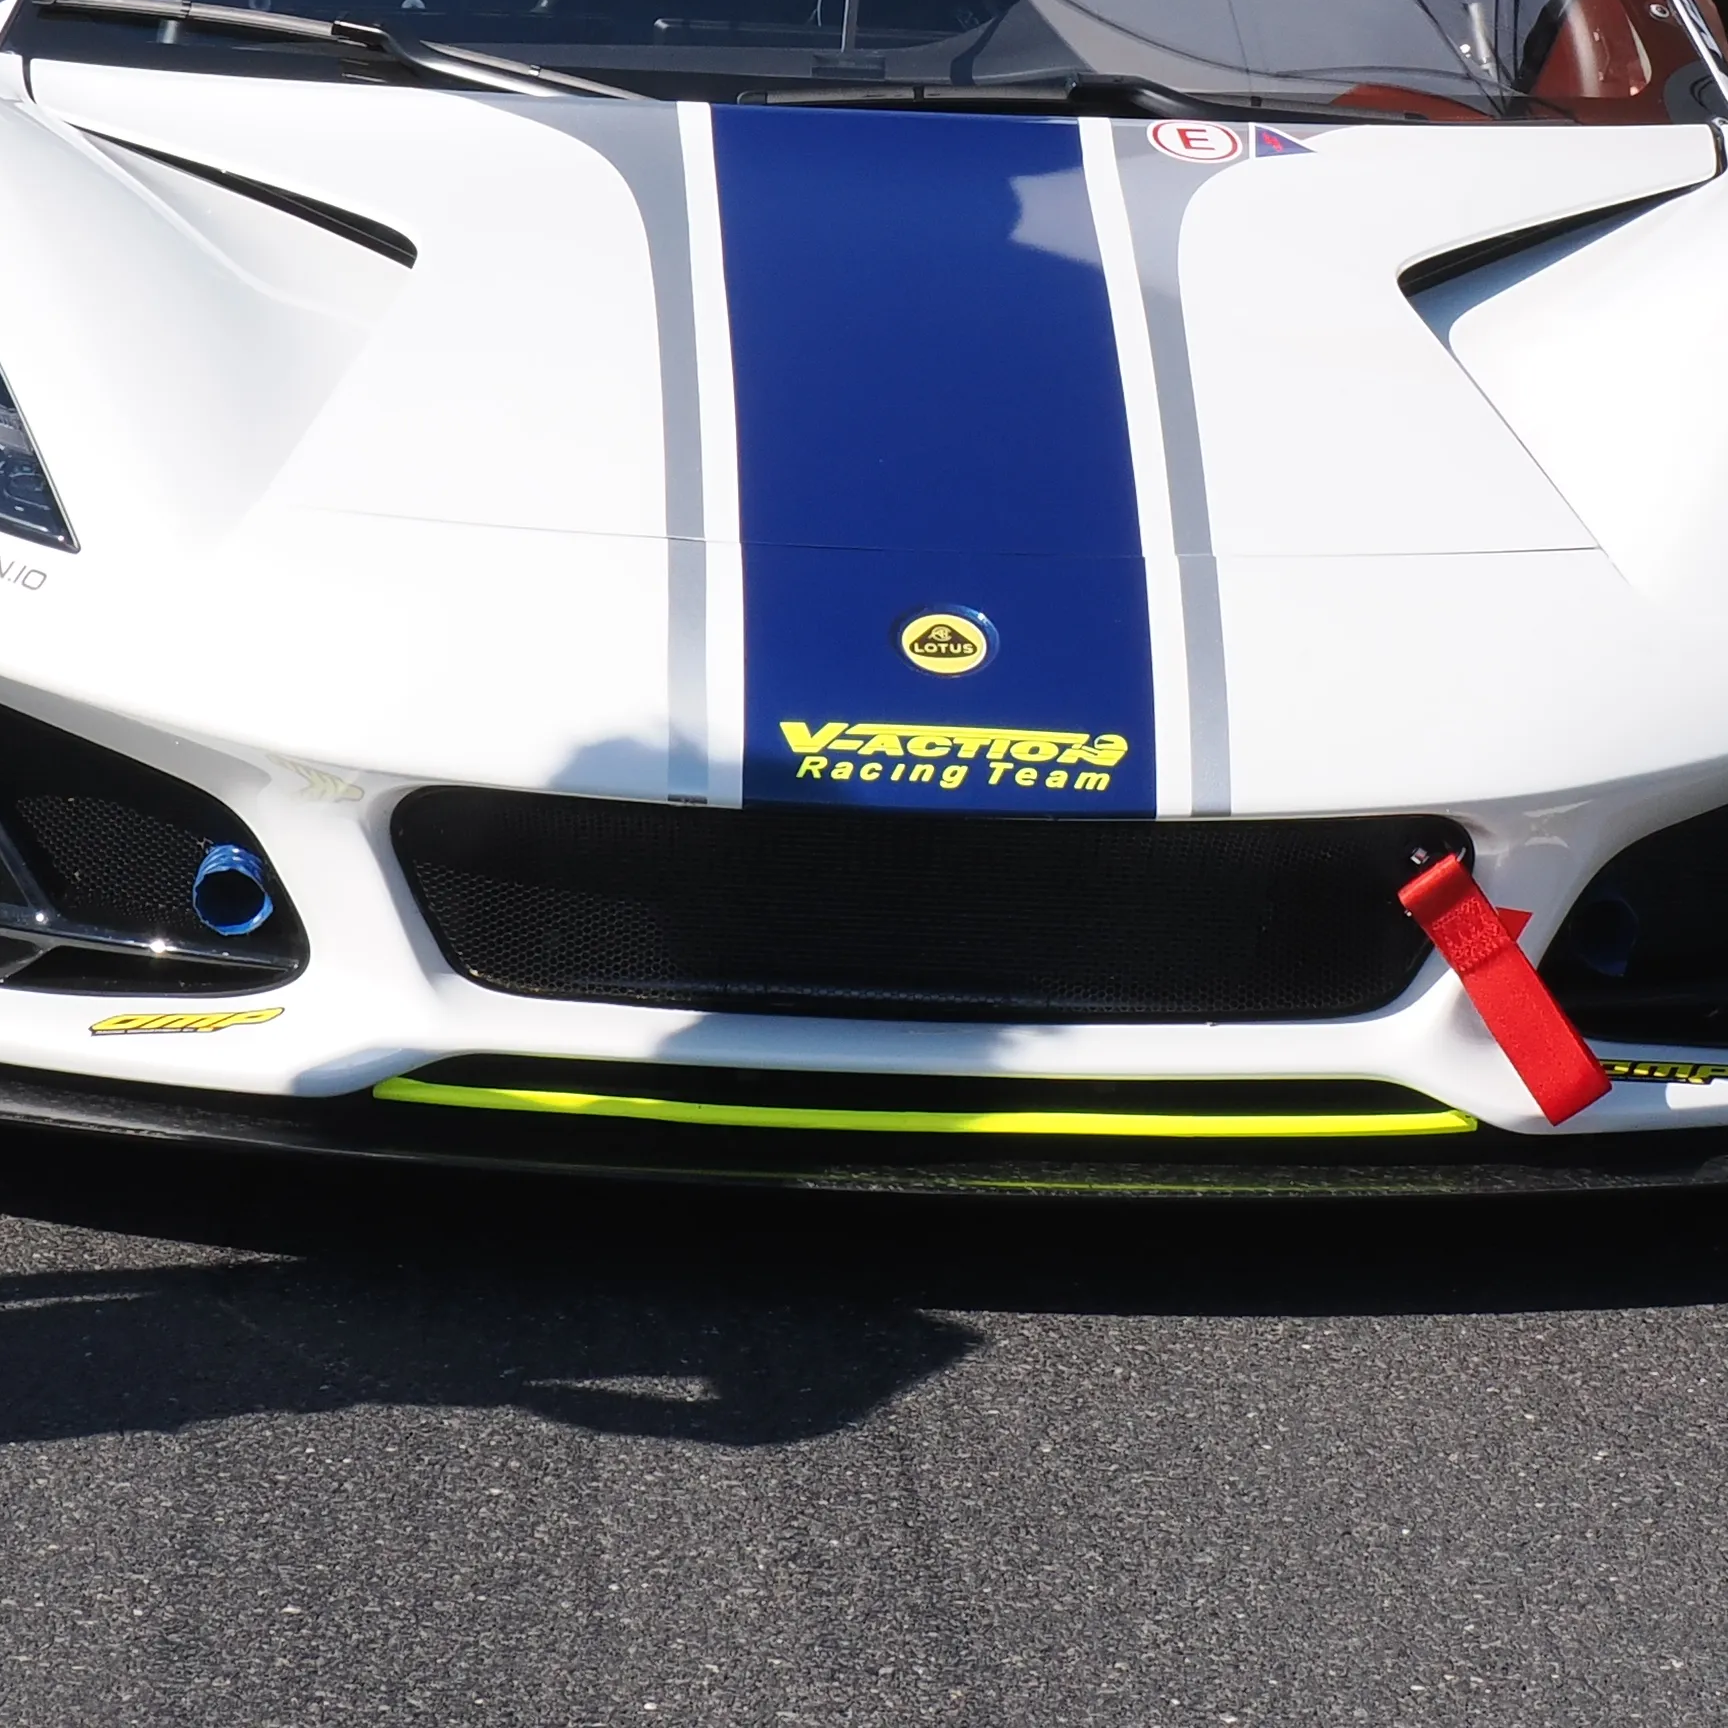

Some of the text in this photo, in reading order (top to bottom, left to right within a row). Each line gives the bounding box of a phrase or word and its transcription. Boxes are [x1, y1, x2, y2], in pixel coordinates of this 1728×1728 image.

[1176, 127, 1216, 152] E
[912, 640, 975, 657] LOTUS
[795, 755, 1112, 792] Racing Team
